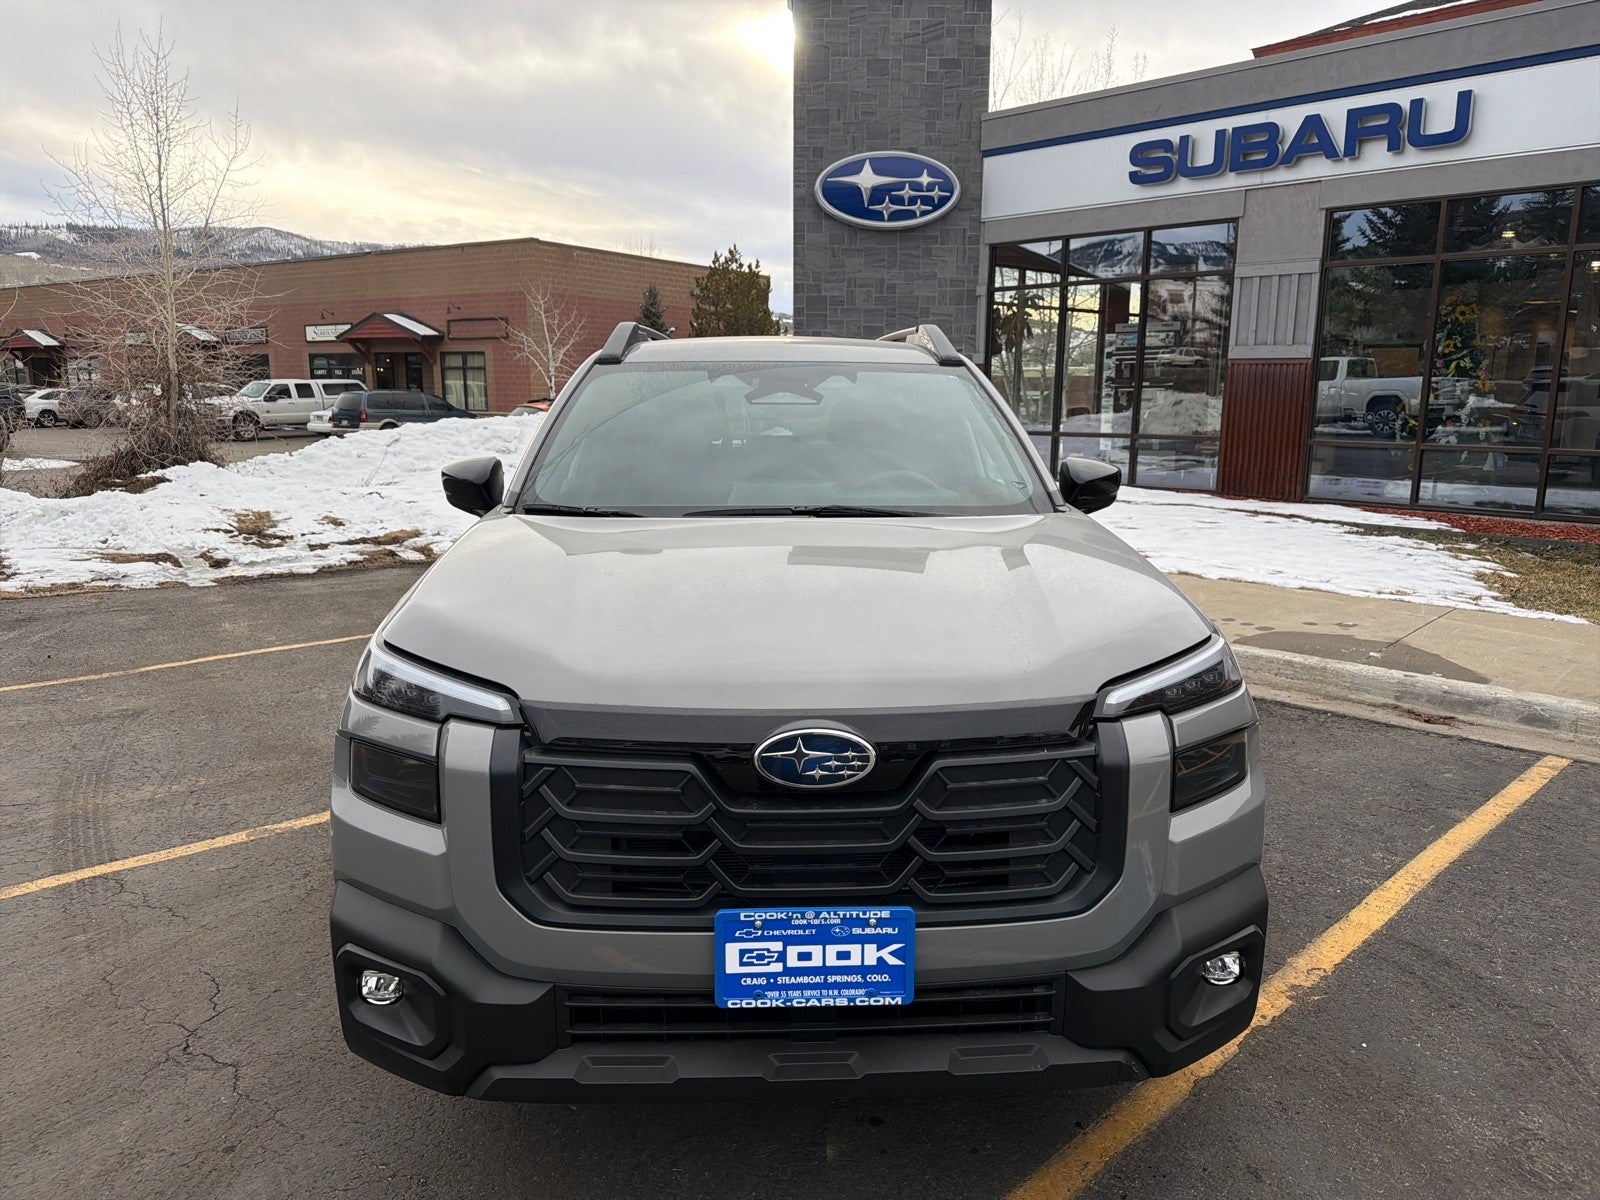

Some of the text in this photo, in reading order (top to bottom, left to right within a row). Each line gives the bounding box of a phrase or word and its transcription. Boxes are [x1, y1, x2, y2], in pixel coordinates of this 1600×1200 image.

[1128, 89, 1474, 186] SUBARU
[805, 911, 815, 919] @
[819, 910, 891, 919] ALTITUDE
[791, 918, 841, 926] cook-cars.com
[764, 928, 817, 936] CHEVROLET
[852, 927, 898, 935] SUBARU
[725, 941, 906, 974] COOK
[741, 973, 891, 986] CRAIG STEAMBOAT SPRINGS, COLO.
[821, 989, 828, 997] TO
[727, 997, 902, 1009] COOK-CARS.COM
